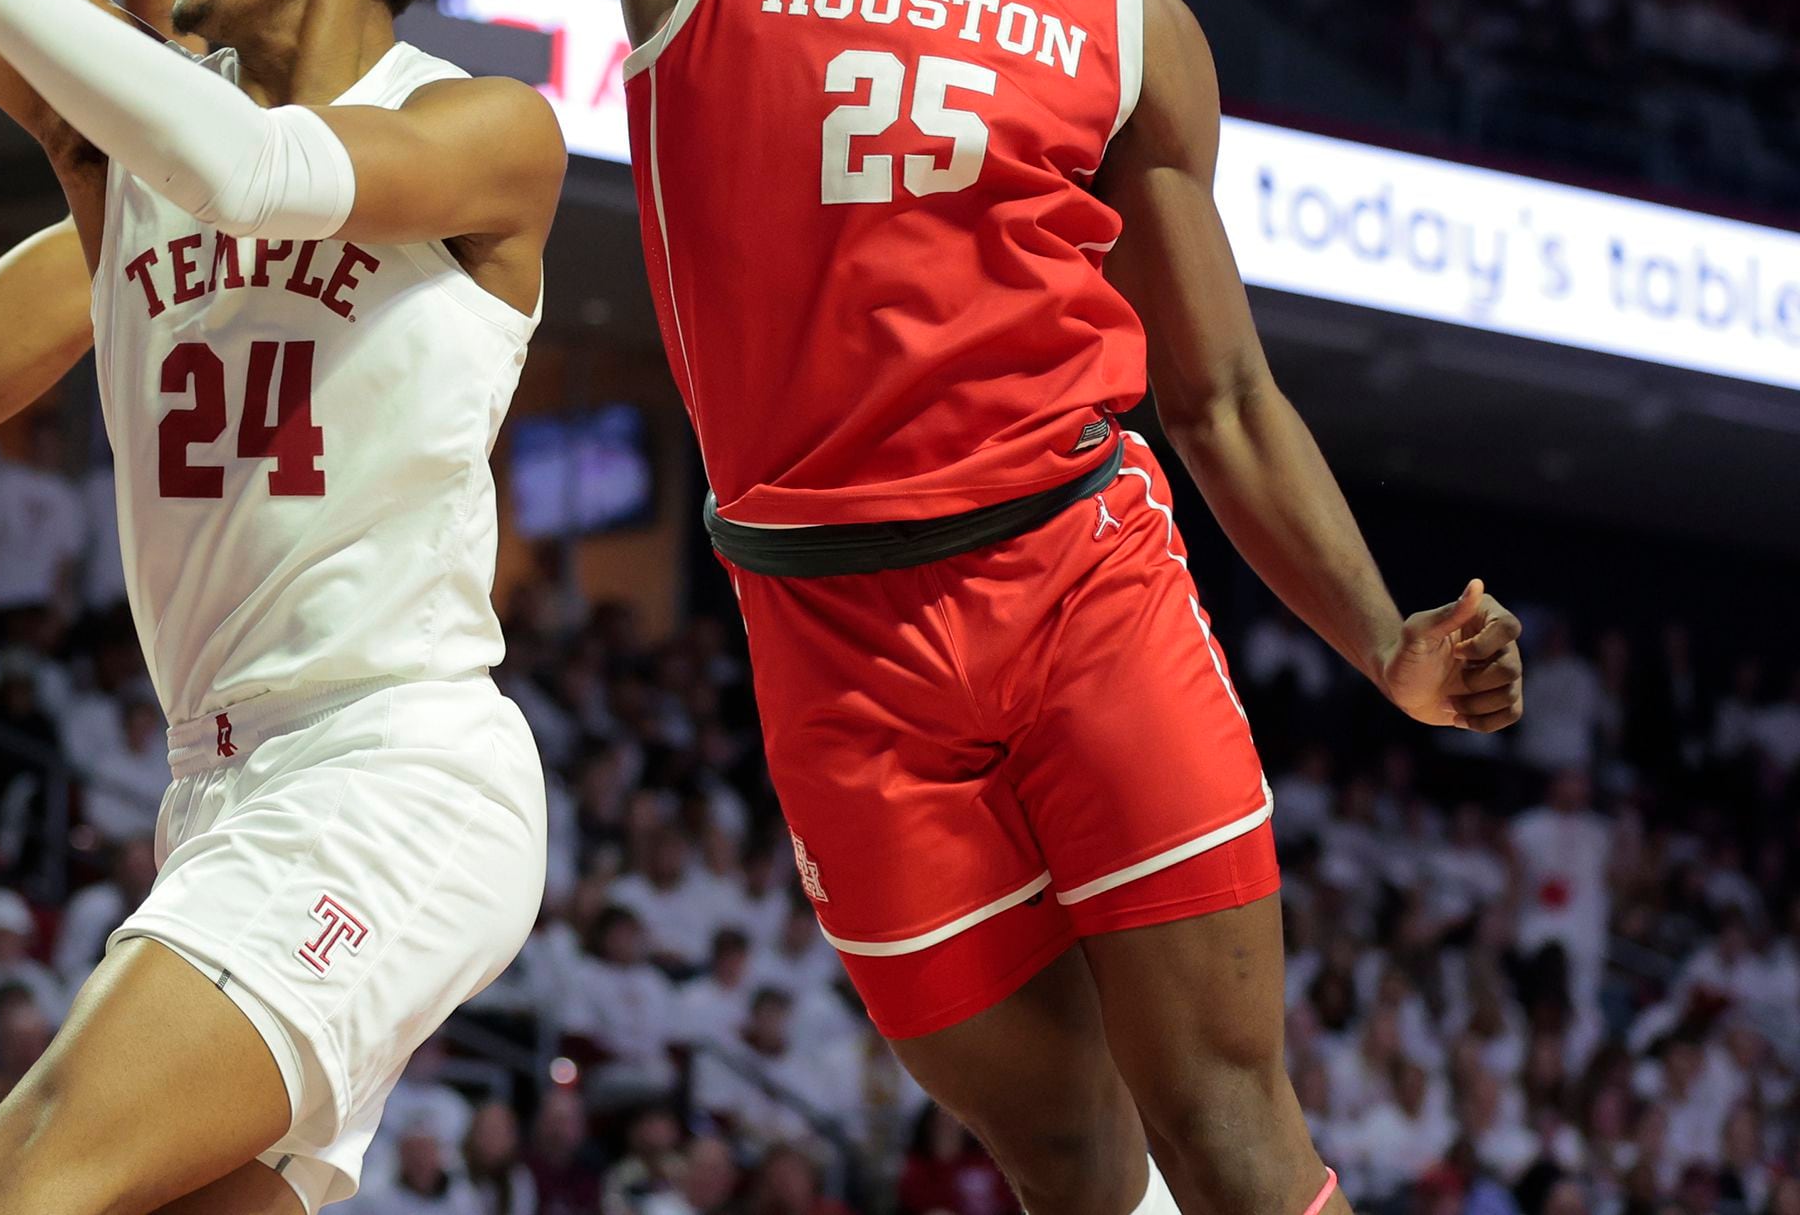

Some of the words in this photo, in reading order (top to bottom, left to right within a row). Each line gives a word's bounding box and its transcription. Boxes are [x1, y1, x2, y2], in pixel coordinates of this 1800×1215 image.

[821, 49, 998, 205] 25
[124, 230, 381, 320] TEMPLE
[1256, 164, 1572, 318] today's
[158, 340, 326, 498] 24
